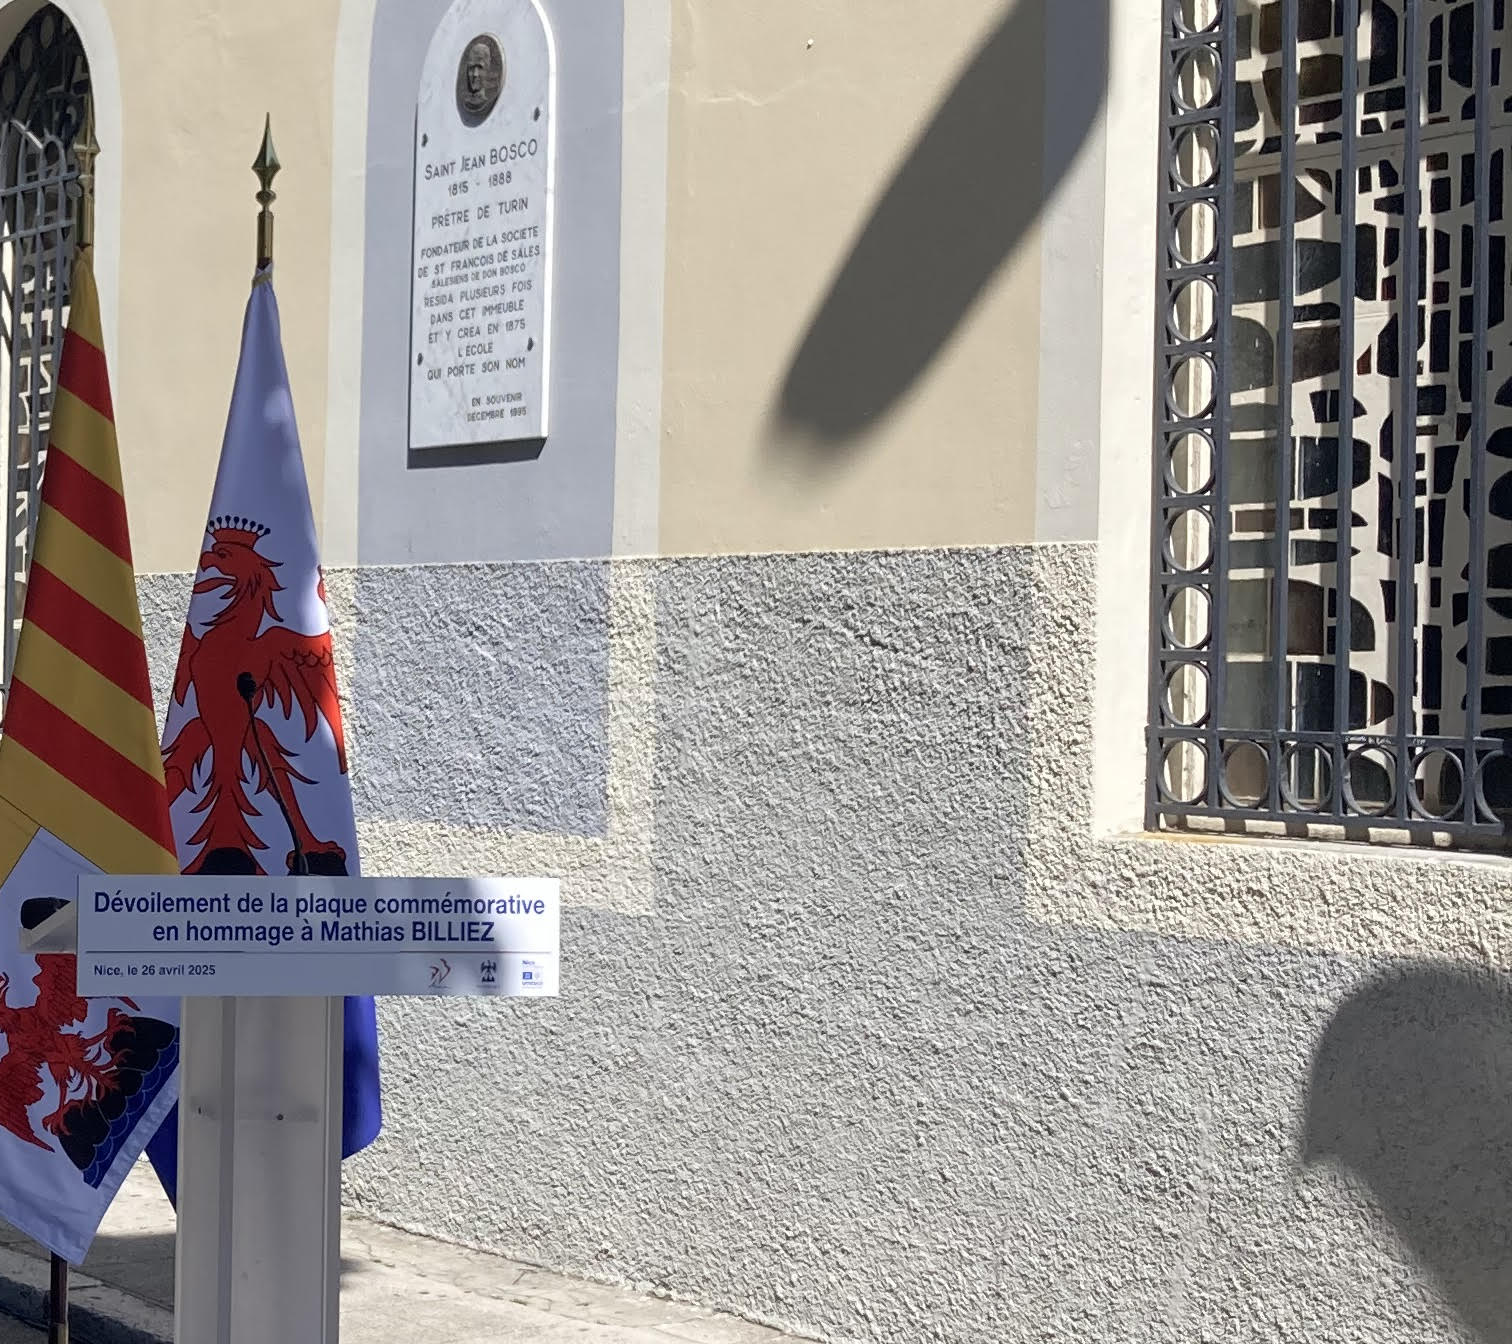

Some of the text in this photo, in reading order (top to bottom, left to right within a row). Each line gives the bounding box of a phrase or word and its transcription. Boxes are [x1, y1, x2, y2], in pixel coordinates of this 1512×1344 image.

[424, 138, 538, 180] SAINT JEAN BOSCO
[448, 180, 469, 197] 1815
[488, 170, 512, 187] 1888
[477, 204, 490, 220] DE
[498, 197, 529, 215] TURIN
[421, 239, 470, 260] FONDATEUR
[472, 236, 484, 250] DE
[486, 234, 498, 247] LA
[417, 266, 429, 279] DE
[434, 262, 445, 275] ST
[497, 250, 509, 263] DE
[511, 244, 541, 261] SALES
[471, 271, 480, 282] DE
[482, 267, 498, 279] DON
[499, 262, 527, 276] BOSCO
[459, 283, 506, 303] PLUSIEURS
[511, 279, 533, 293] FOIS
[430, 299, 525, 326] DANS CET IMMEUBLE
[428, 332, 439, 345] ET
[445, 329, 451, 342] Y
[487, 323, 499, 335] EN
[505, 318, 526, 332] 1875
[427, 357, 526, 381] QUI PORTE SON NOM
[93, 889, 546, 919] Dévoilement de la plaque commémorative
[152, 918, 495, 947] en hommage à Mathias BILLIEZ
[93, 964, 217, 978] Nice, le 26 avril 2025
